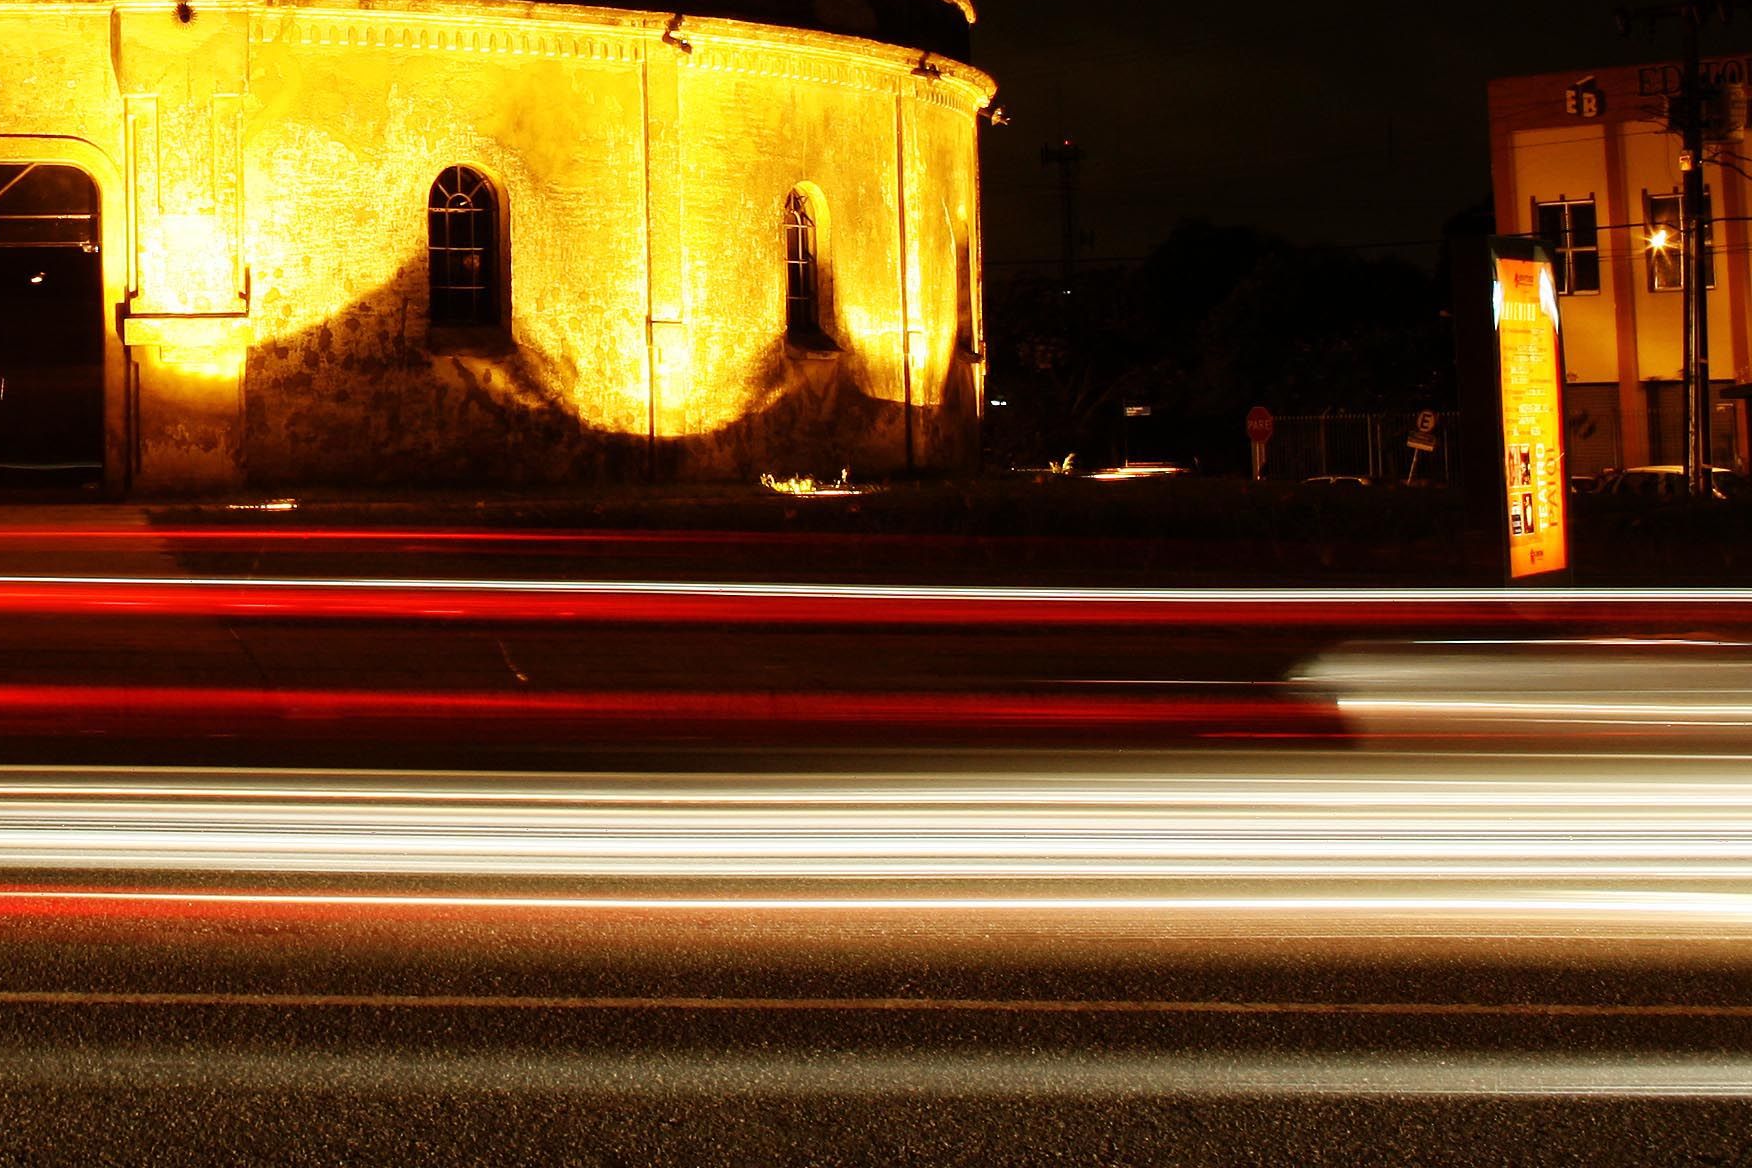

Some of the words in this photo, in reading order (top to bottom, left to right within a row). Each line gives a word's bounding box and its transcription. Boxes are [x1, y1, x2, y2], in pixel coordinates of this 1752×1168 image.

[1247, 417, 1273, 432] PARE
[1420, 413, 1433, 429] E
[1535, 443, 1550, 532] TEATRO
